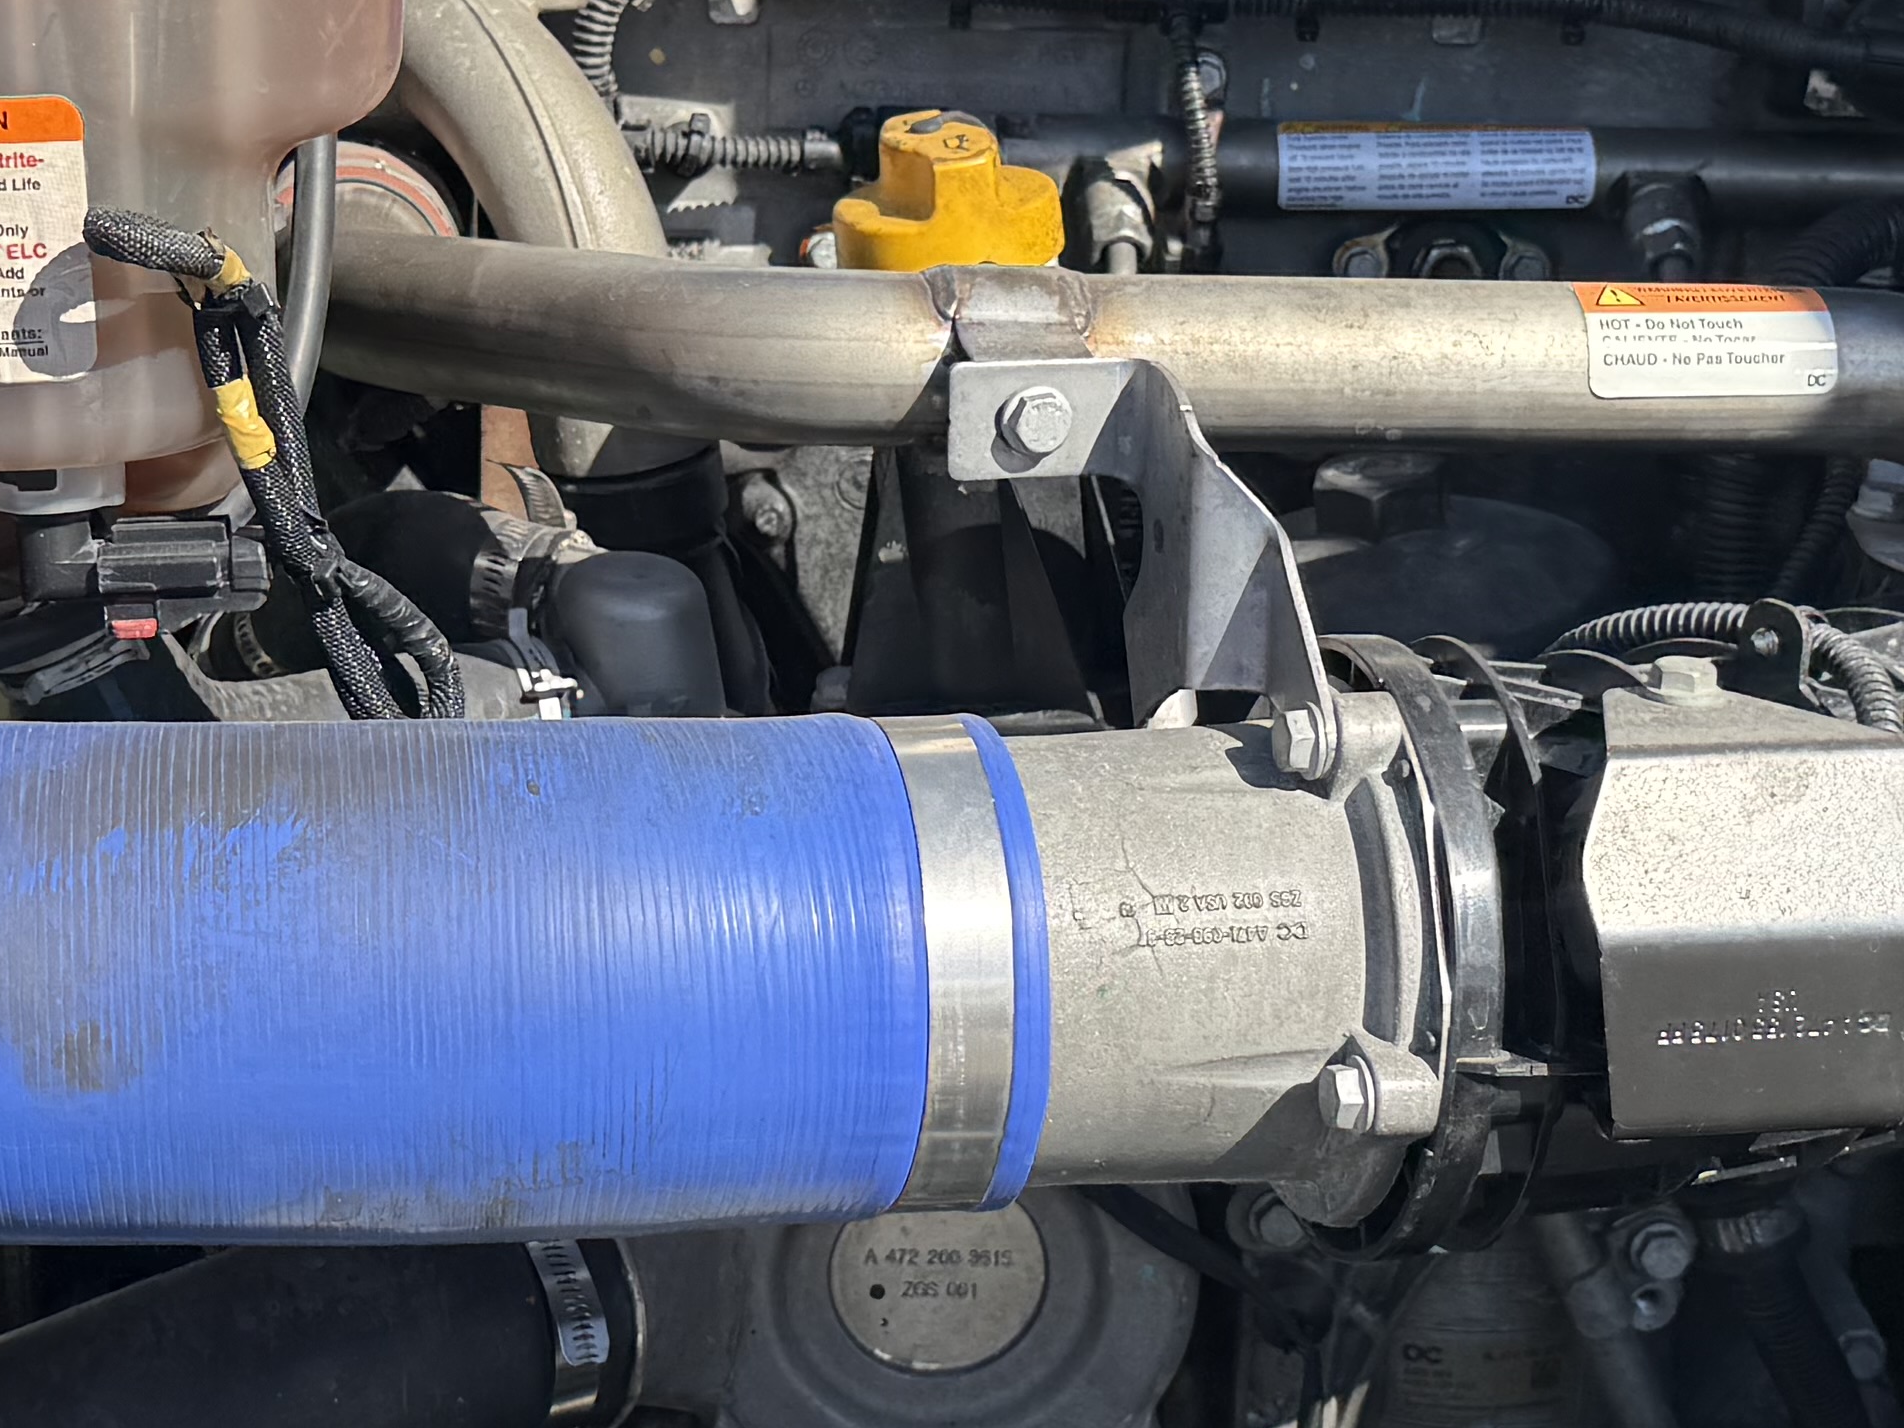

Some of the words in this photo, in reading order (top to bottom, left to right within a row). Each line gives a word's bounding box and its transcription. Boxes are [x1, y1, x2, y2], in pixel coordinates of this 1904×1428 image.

[11, 178, 42, 192] Life
[6, 242, 47, 260] ELC
[30, 287, 46, 297] or
[1599, 318, 1631, 331] HOT
[1645, 319, 1665, 331] Do
[1670, 318, 1696, 331] Not
[1699, 318, 1743, 331] Touch
[1603, 353, 1658, 367] CHAUD
[1807, 373, 1827, 388] DC
